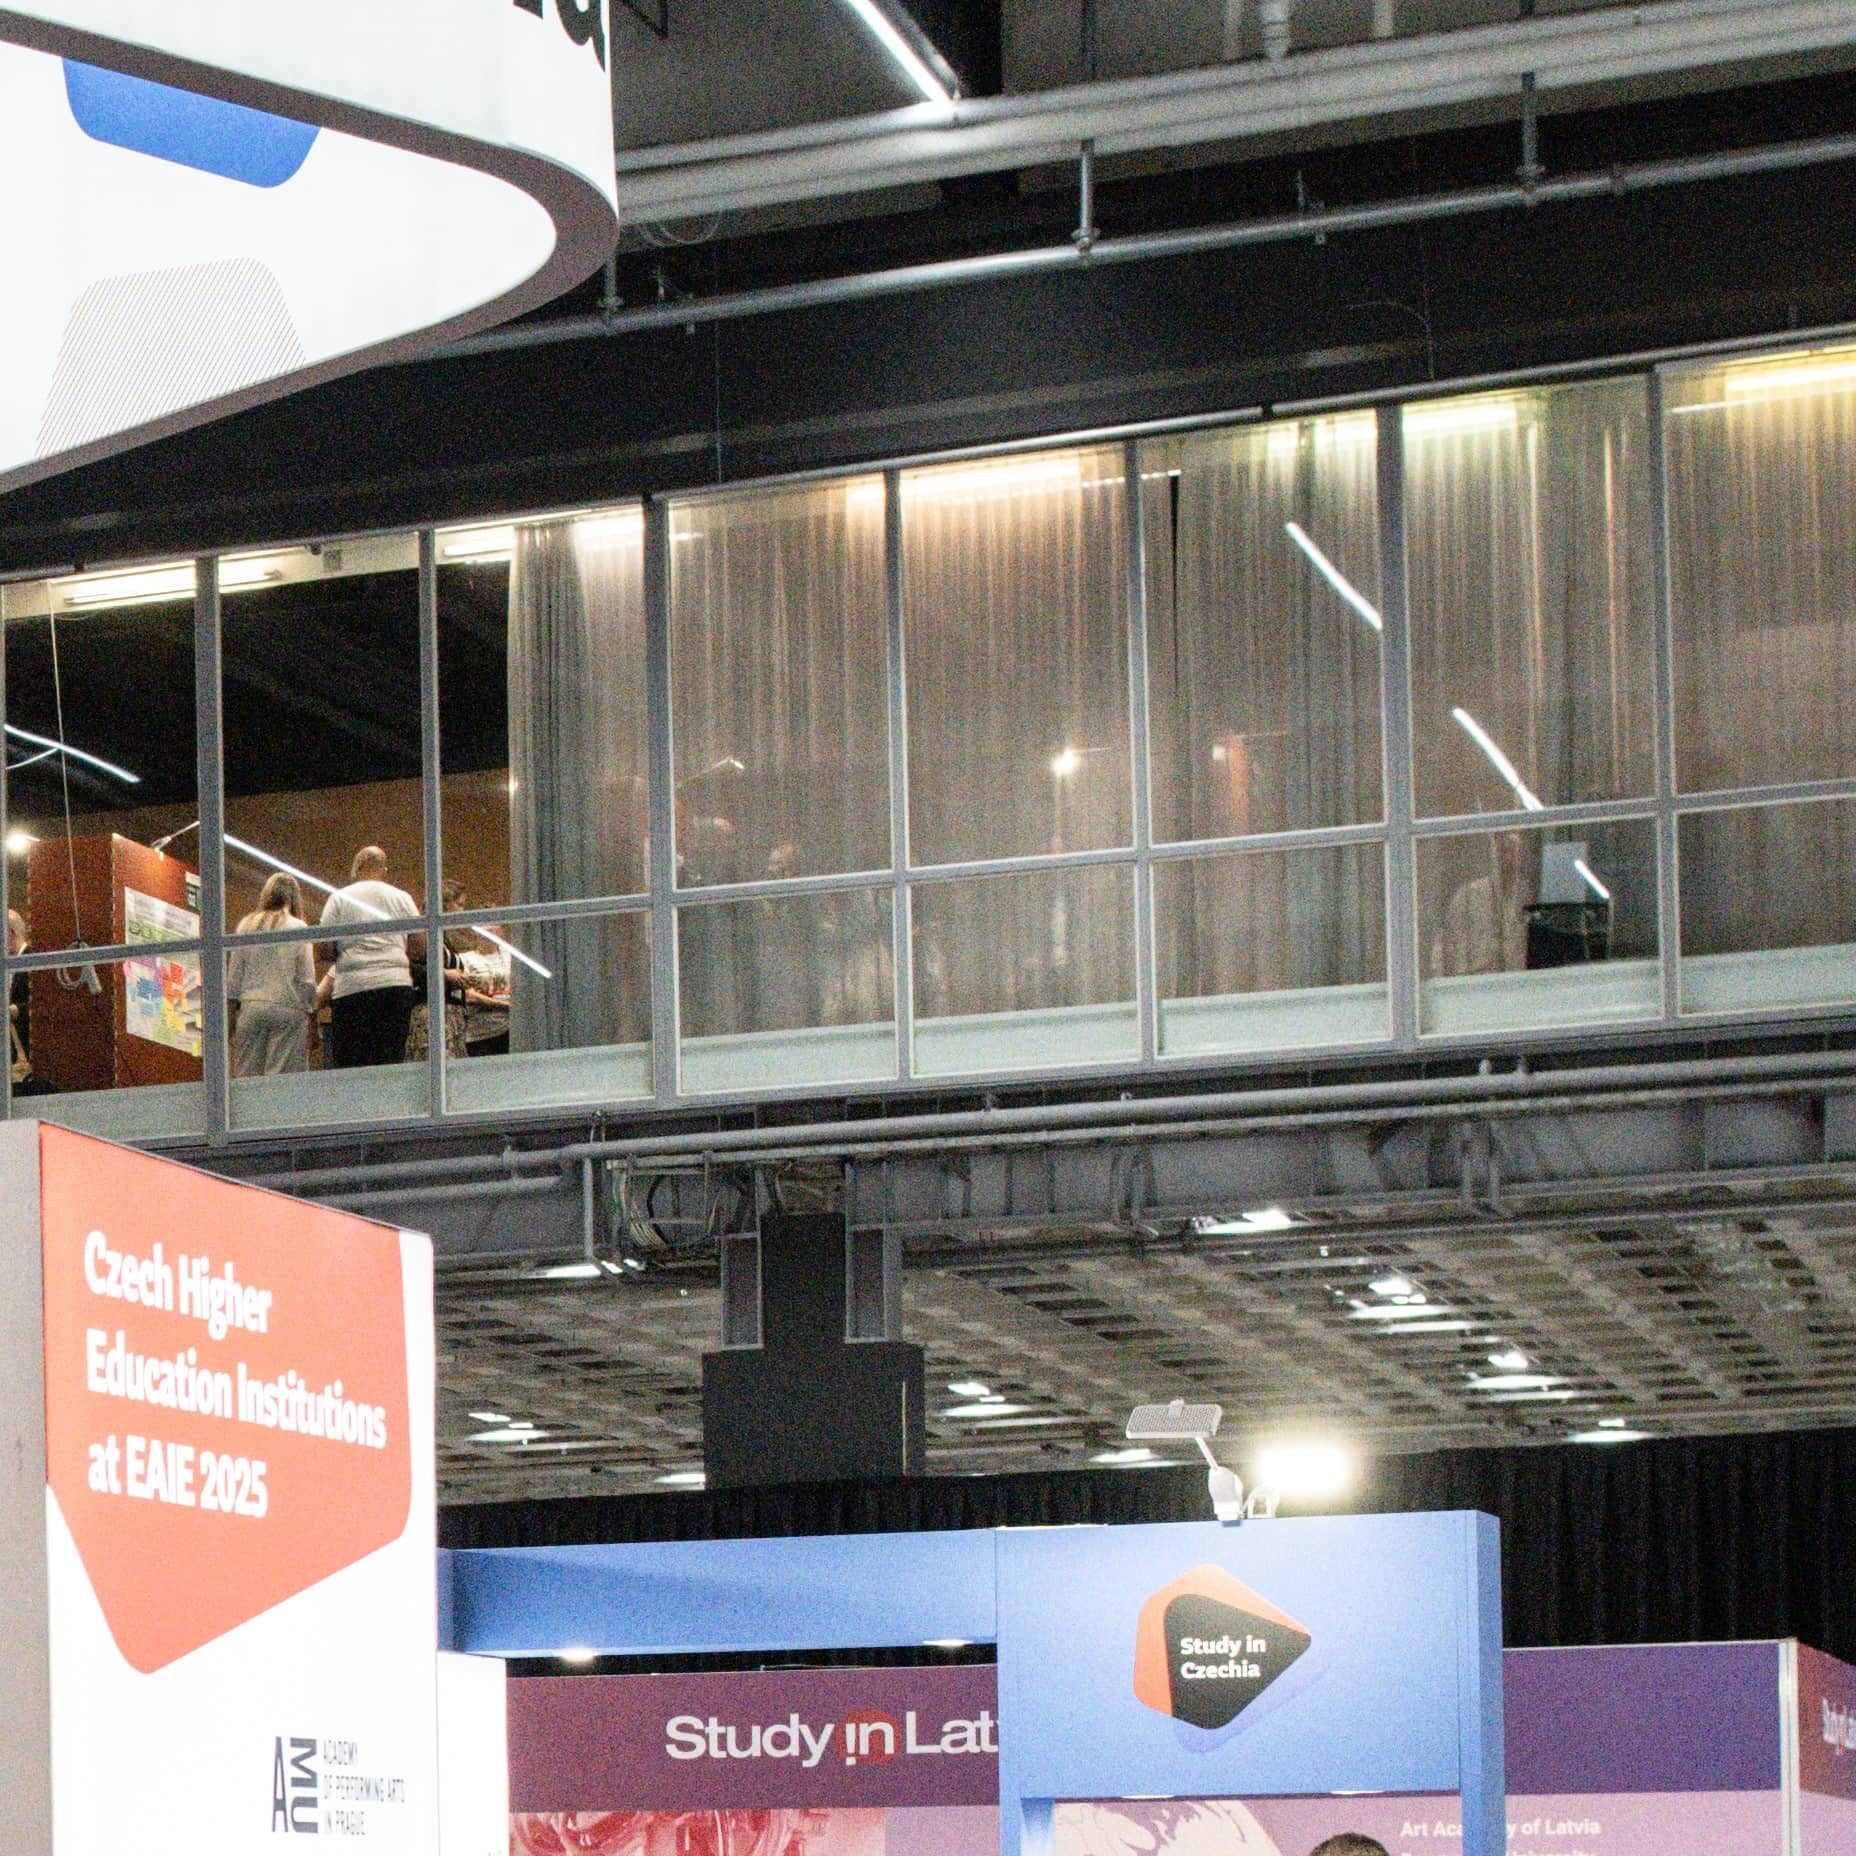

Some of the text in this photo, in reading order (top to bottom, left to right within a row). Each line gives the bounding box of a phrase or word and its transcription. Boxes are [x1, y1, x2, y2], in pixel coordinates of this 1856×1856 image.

[84, 1229, 273, 1341] Czech Higher
[85, 1328, 387, 1449] Education Institutions
[87, 1433, 268, 1518] at EAIE 2025
[1180, 1635, 1267, 1657] Study in
[1180, 1660, 1262, 1679] Czechia
[665, 1712, 835, 1768] Study
[906, 1711, 1000, 1754] Lat
[1400, 1822, 1429, 1838] Art
[1522, 1820, 1541, 1835] of
[1545, 1818, 1601, 1836] Latvia
